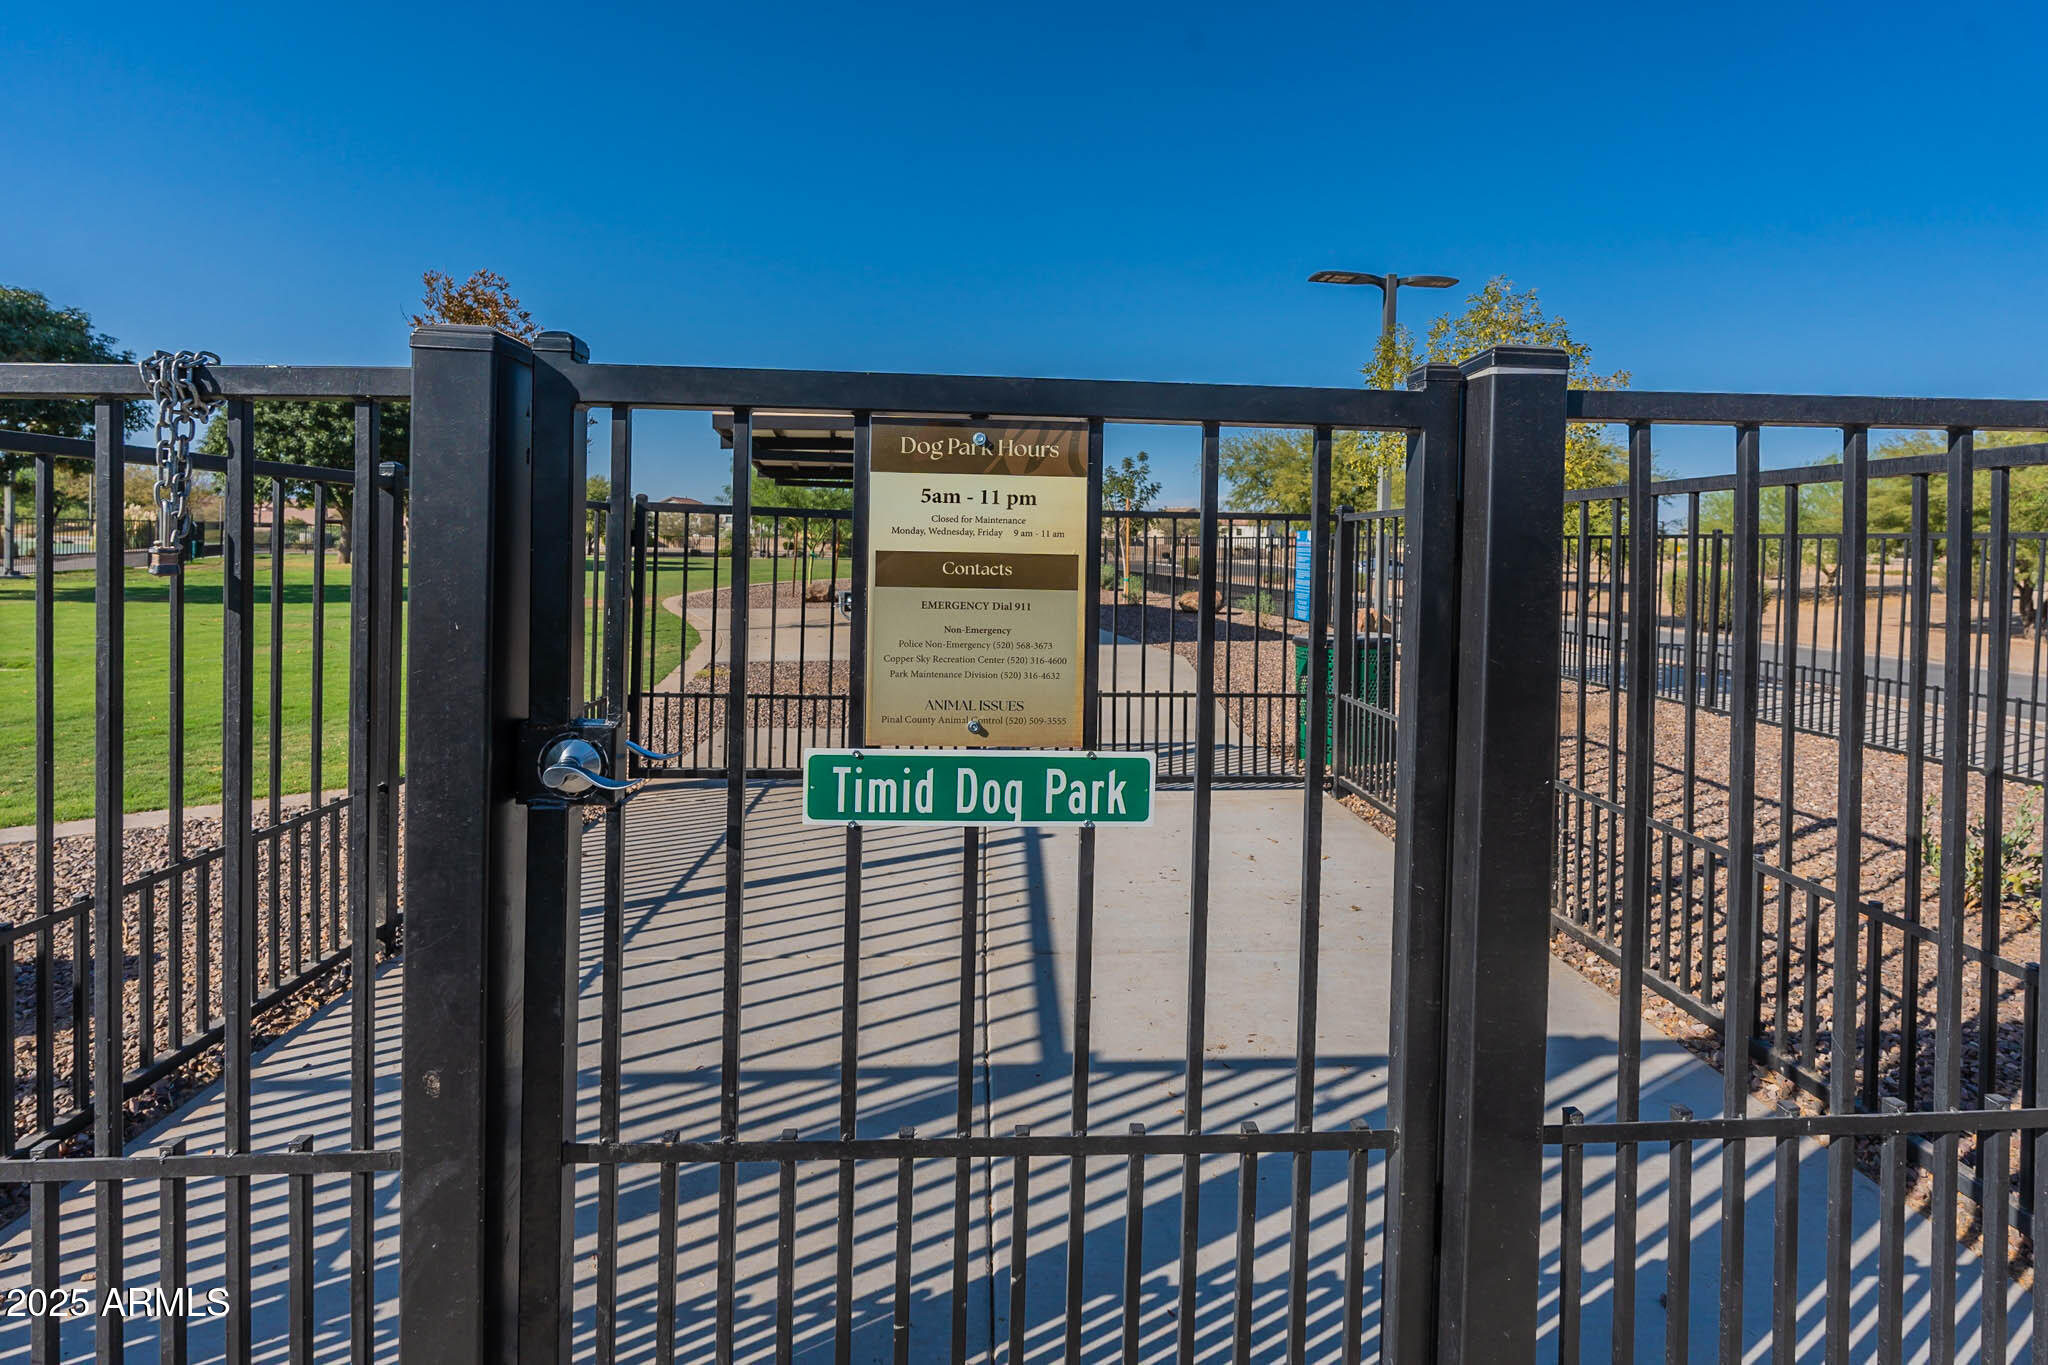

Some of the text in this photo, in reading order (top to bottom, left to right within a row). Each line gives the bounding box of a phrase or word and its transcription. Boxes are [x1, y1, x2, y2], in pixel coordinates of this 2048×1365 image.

[901, 437, 943, 460] Dog
[998, 440, 1059, 457] Hours
[921, 488, 960, 504] 5am
[981, 490, 1000, 505] 11
[1006, 493, 1037, 509] pm
[931, 515, 1026, 525] Closed for Maintenance
[892, 527, 926, 536] Monday,
[929, 528, 975, 537] Wednesday,
[978, 529, 1003, 538] Friday
[943, 562, 1012, 576] Contacts
[922, 601, 1031, 611] EMERGENCY Dial 911
[944, 626, 1011, 636] Non-Emergency
[899, 640, 923, 648] Police
[925, 641, 991, 650] Non-Emergency
[993, 642, 1014, 650] (520)
[884, 655, 914, 664] Copper
[916, 655, 930, 664] Sky
[933, 656, 975, 664] Recreation
[1007, 657, 1028, 665] (520)
[890, 670, 908, 678] Park
[911, 671, 962, 679] Maintenance
[964, 671, 998, 679] Division
[1001, 672, 1021, 680] (520)
[925, 700, 1024, 711] ANIMAL ISSUES
[881, 716, 902, 724] Pinal
[905, 716, 936, 725] County
[938, 716, 969, 724] Animal
[1005, 717, 1026, 726] (520)
[1029, 717, 1067, 725] 509-3555
[833, 767, 934, 813] Timid
[1045, 768, 1126, 814] Park
